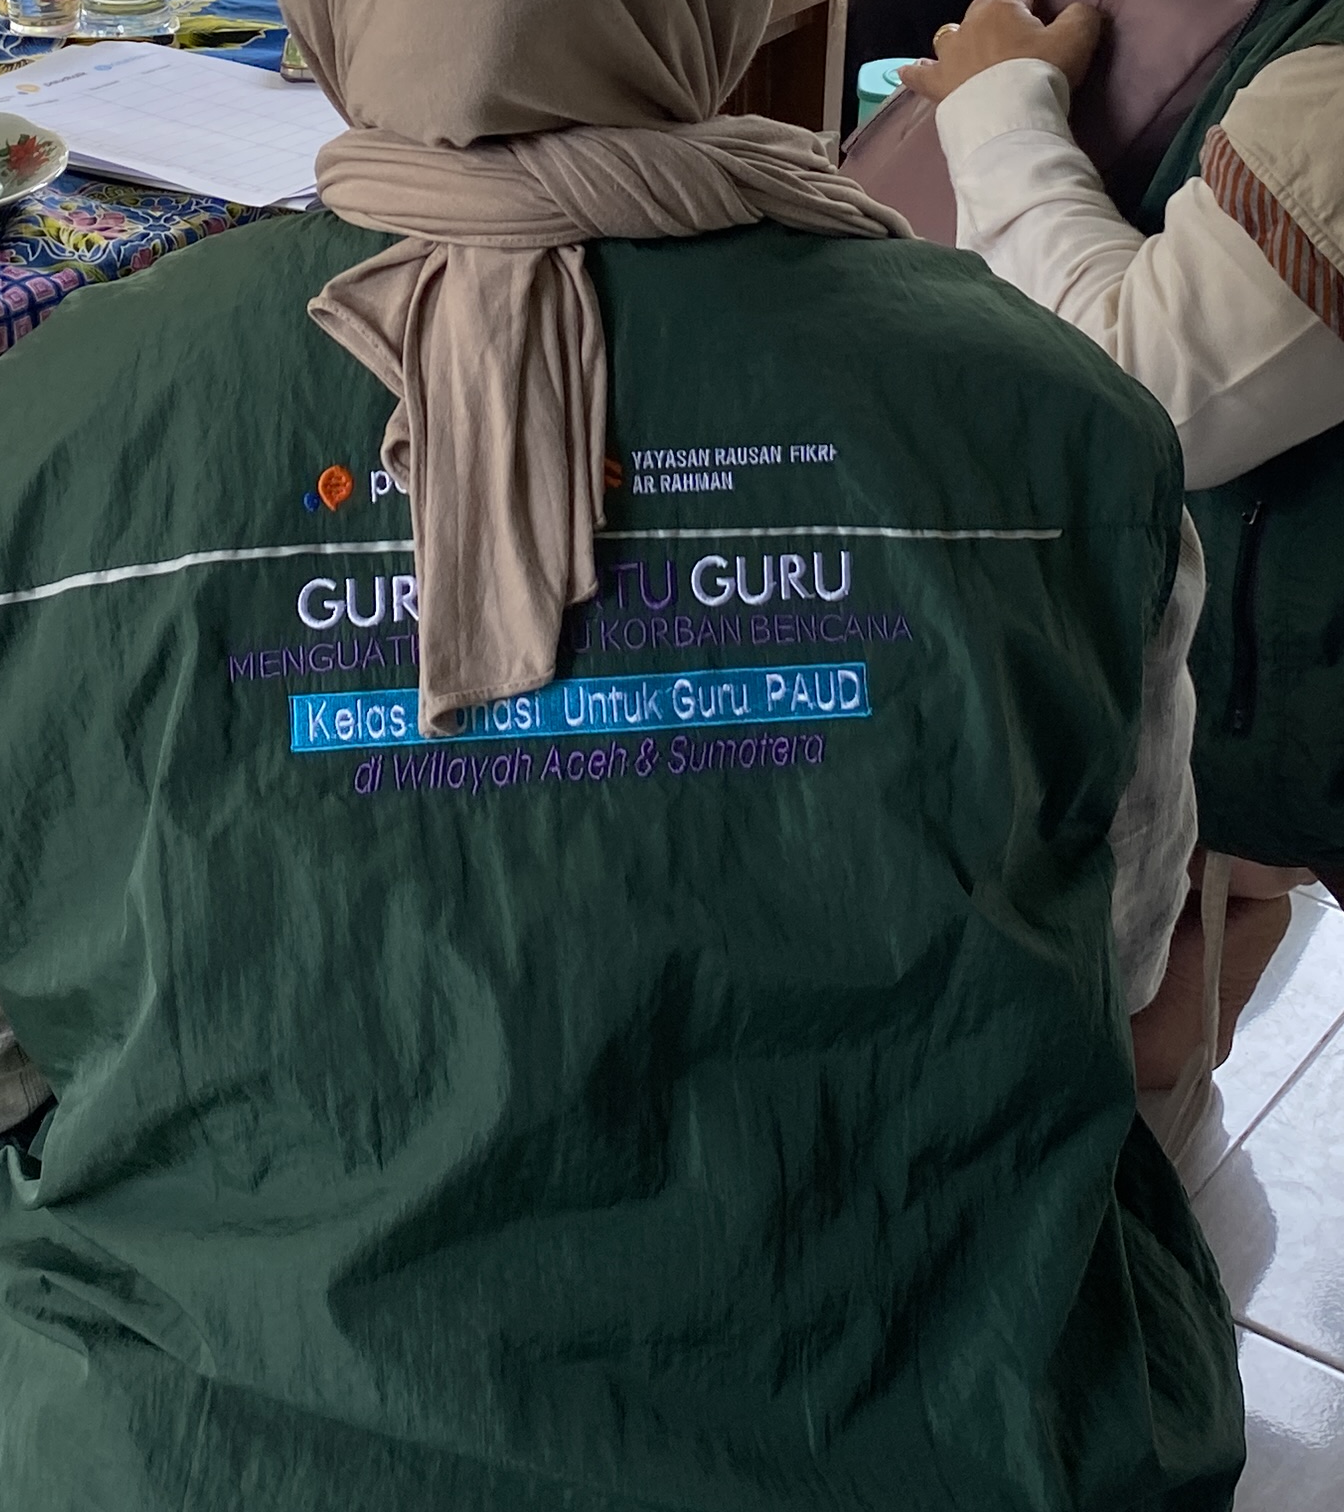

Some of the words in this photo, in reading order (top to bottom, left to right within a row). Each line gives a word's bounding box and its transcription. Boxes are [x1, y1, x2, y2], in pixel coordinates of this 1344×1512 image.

[631, 448, 710, 470] YAYASAN
[714, 445, 782, 467] RAUSAN
[632, 473, 656, 495] AR
[660, 471, 733, 493] RAHMAN
[297, 575, 419, 629] GUR
[690, 550, 851, 607] GURU
[600, 613, 742, 652] KORBAN
[751, 613, 914, 646] BENCANA
[307, 698, 406, 742] Kelas
[456, 690, 541, 736] onasi
[562, 682, 663, 727] Untuk
[670, 678, 752, 720] Guru
[765, 670, 860, 712] PAUD
[354, 754, 383, 794] di
[393, 747, 532, 796] Wilayah
[540, 740, 628, 781] Aceh
[634, 737, 658, 777] &
[667, 733, 824, 775] Sumatera
